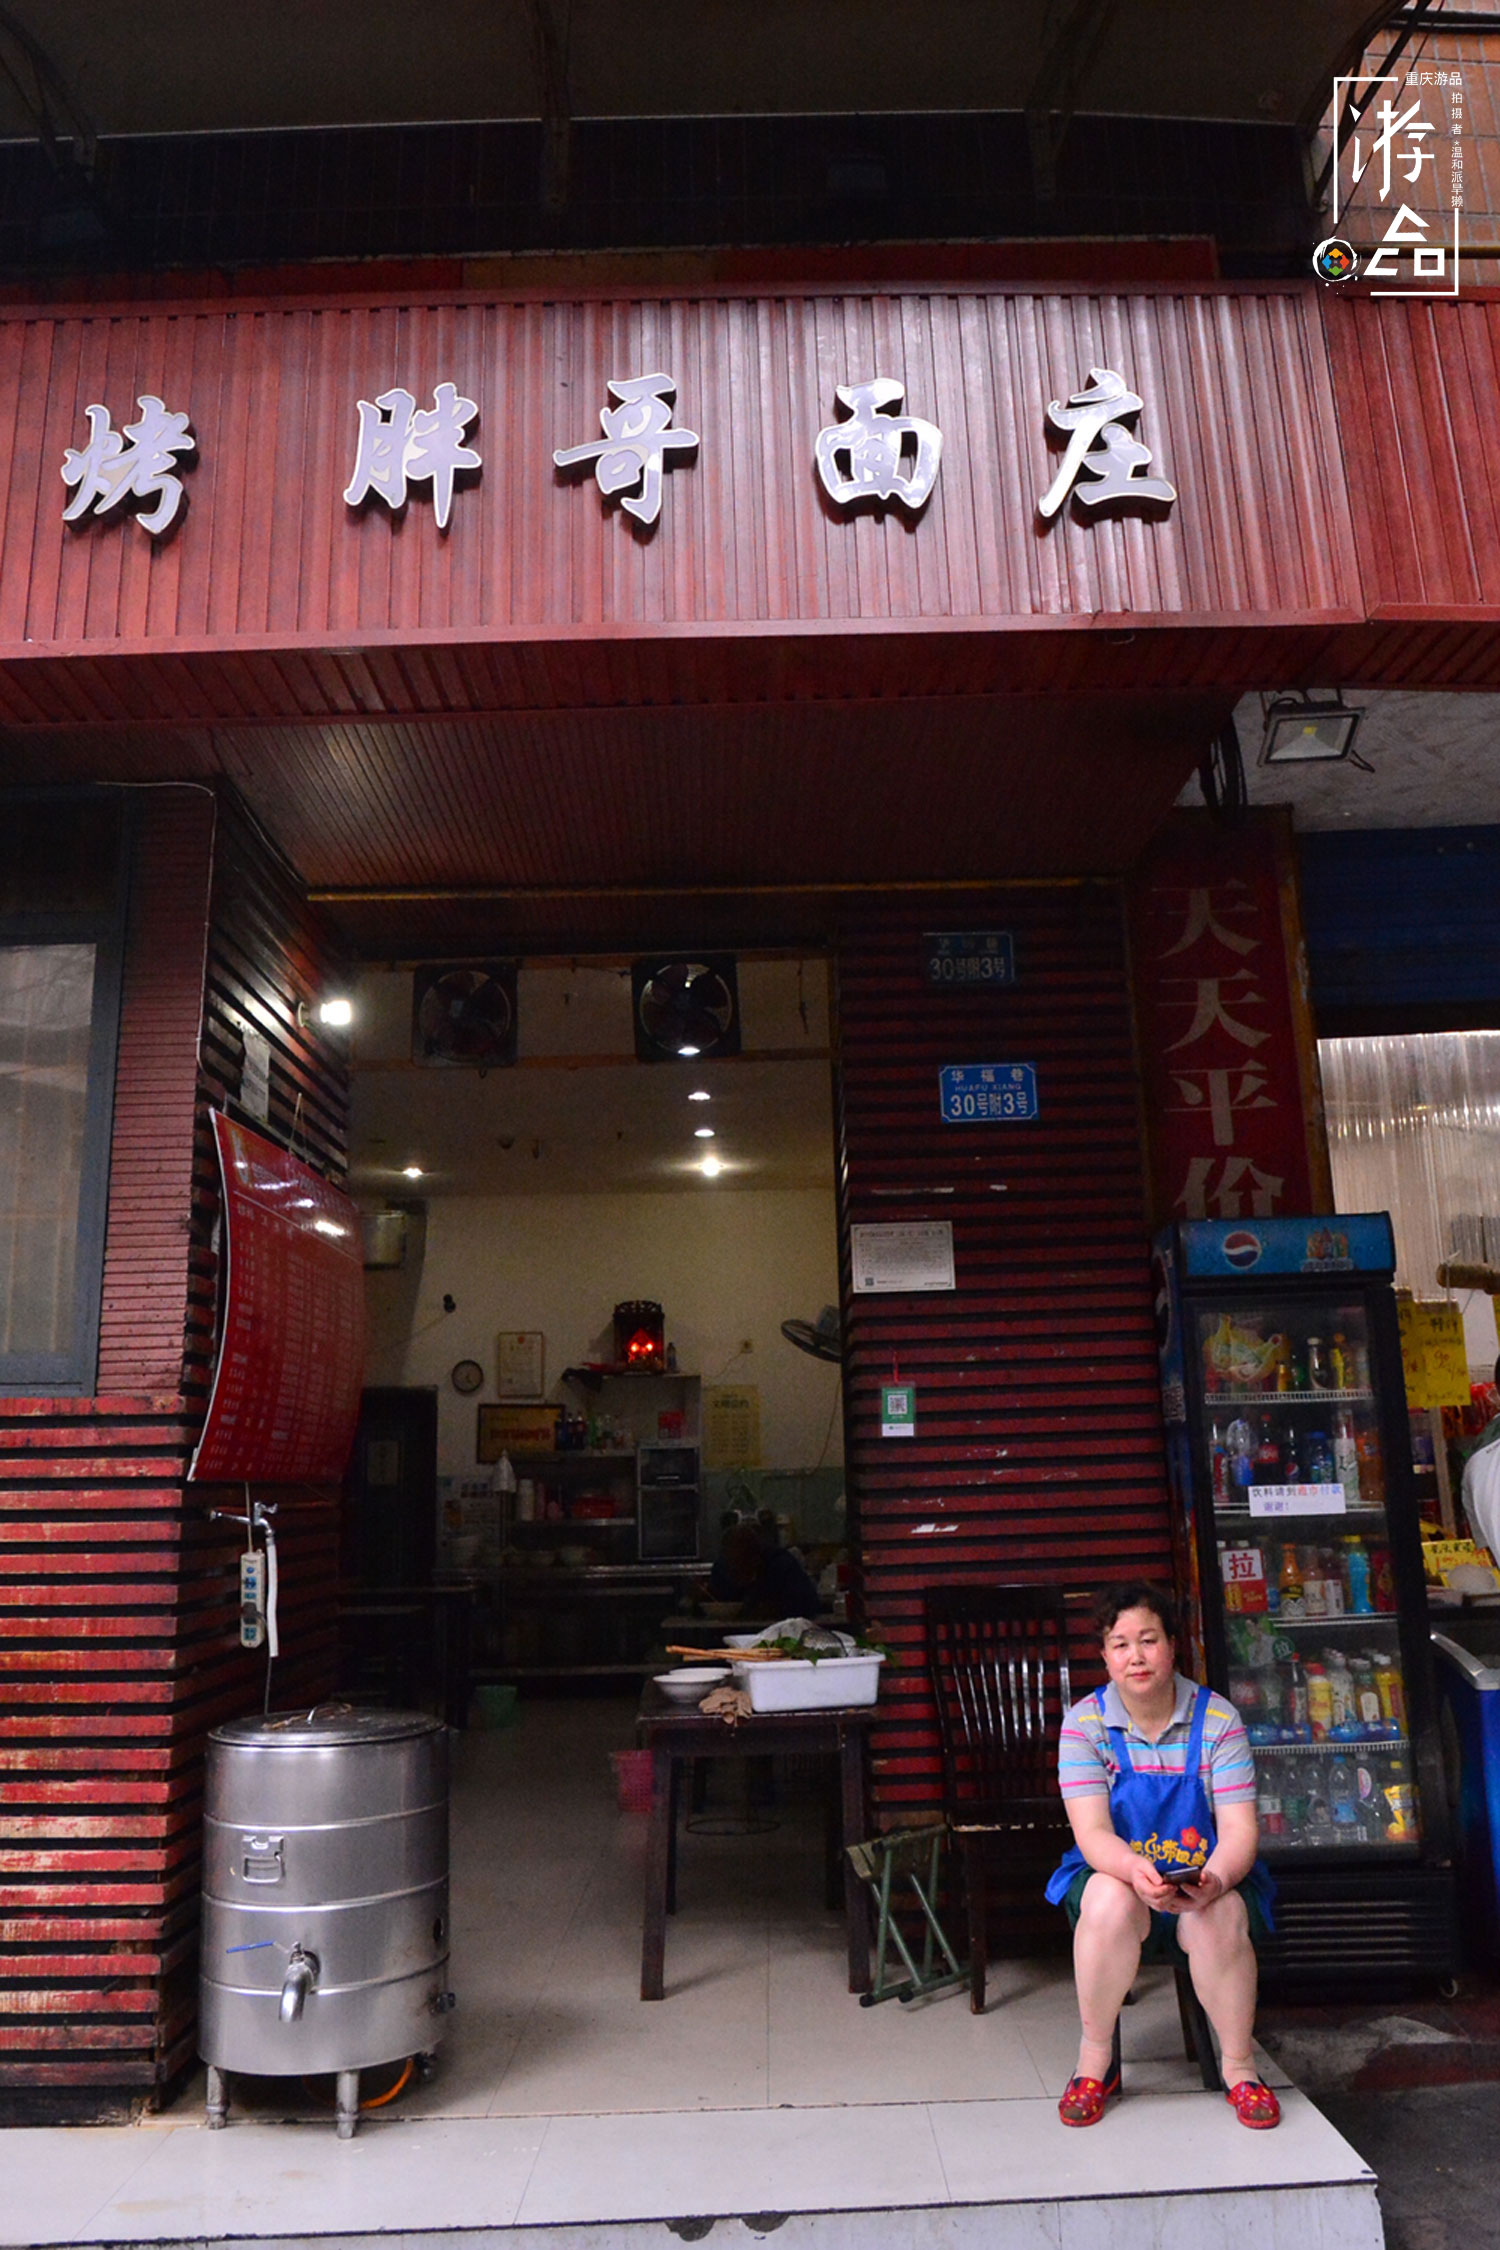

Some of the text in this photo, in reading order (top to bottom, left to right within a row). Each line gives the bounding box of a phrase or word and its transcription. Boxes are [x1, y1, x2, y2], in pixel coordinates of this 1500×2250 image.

[61, 368, 1178, 536] 烤胖哥面庄
[1147, 878, 1285, 1219] 天天平价
[951, 1068, 1025, 1083] 华福巷
[955, 1083, 1022, 1092] HUAFU XIANG
[950, 1091, 1028, 1116] 30号附3号
[1228, 1552, 1256, 1579] 拉
